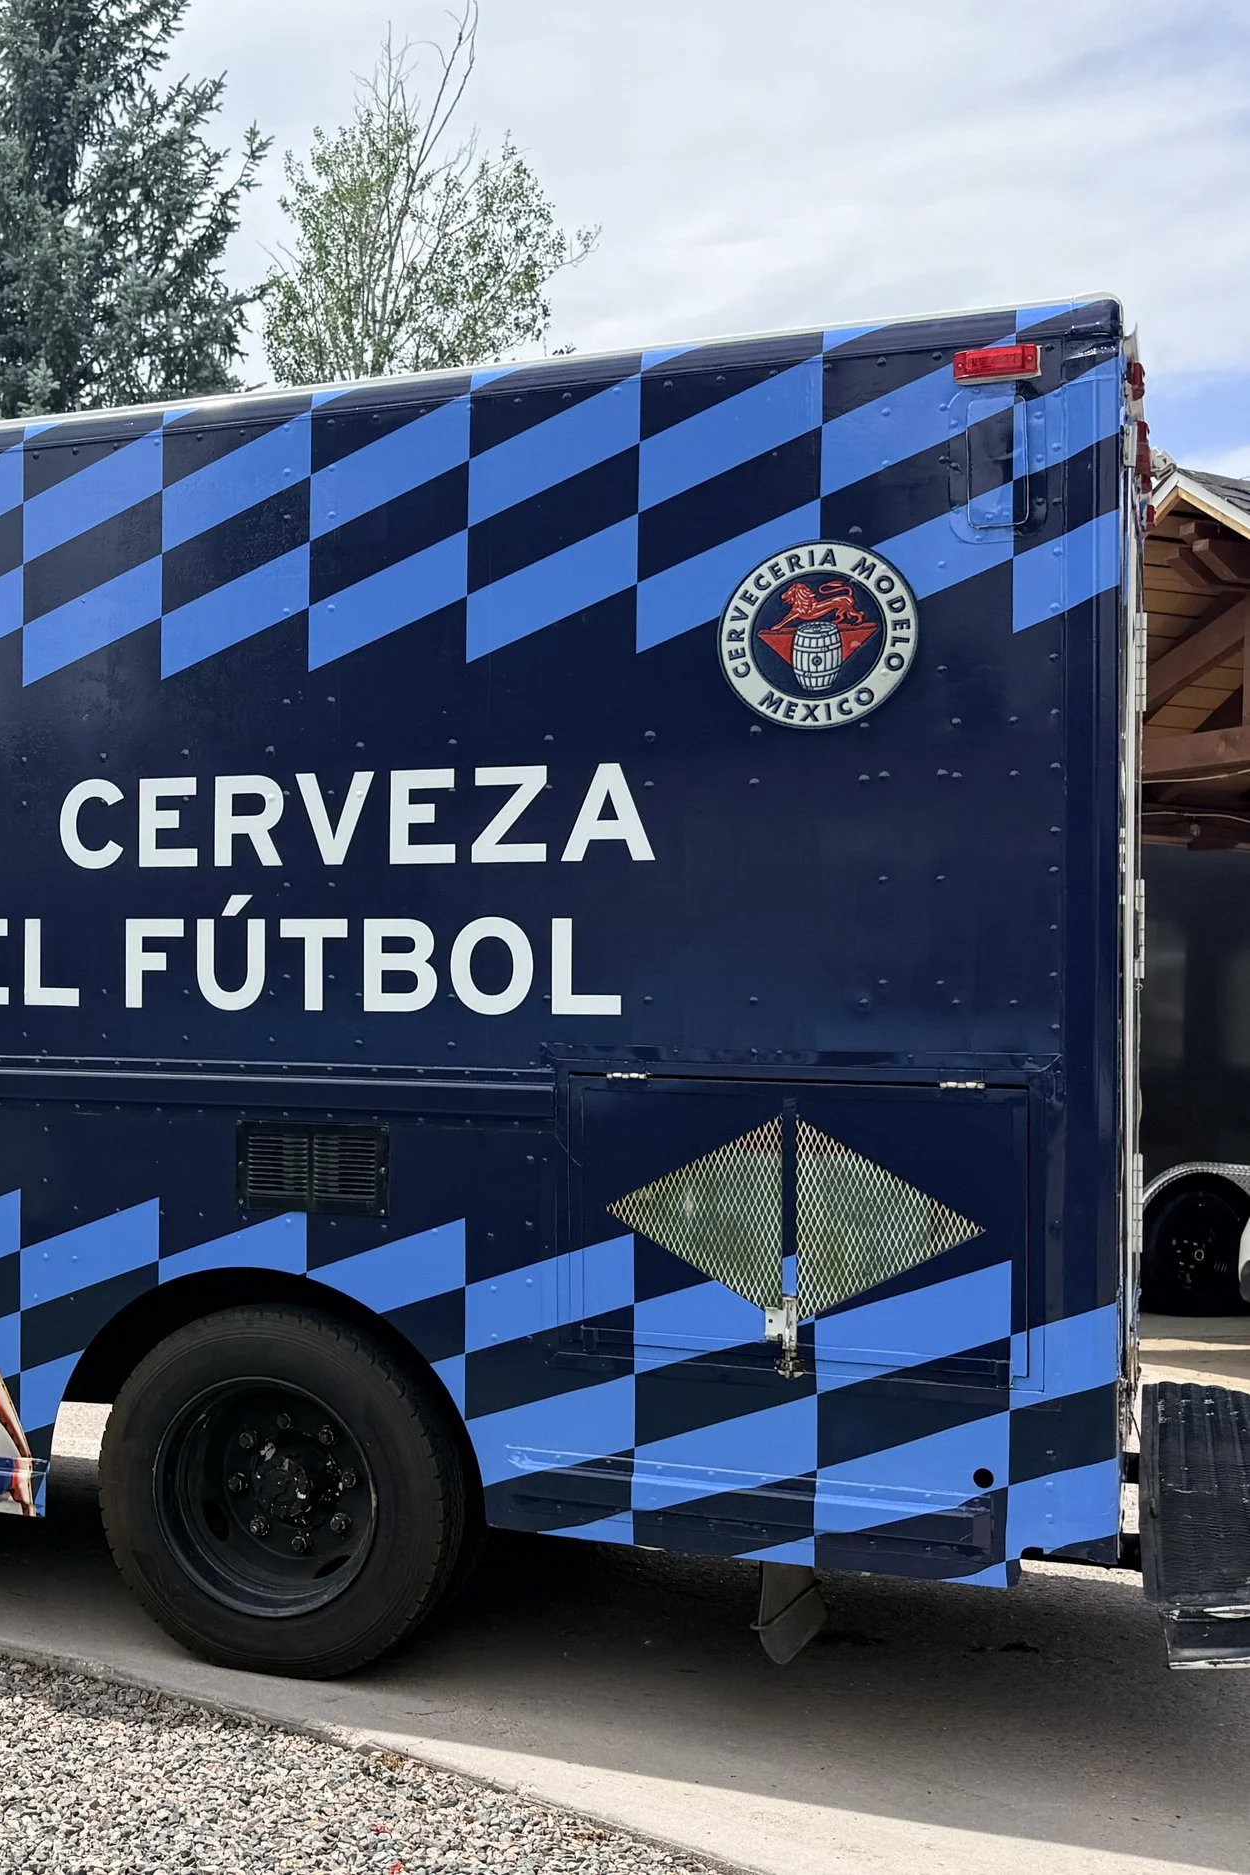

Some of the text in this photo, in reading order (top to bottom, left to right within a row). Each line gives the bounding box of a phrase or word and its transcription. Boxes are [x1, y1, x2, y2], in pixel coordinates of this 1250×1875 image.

[726, 548, 911, 678] CERVECERIA MODELO
[758, 687, 875, 722] MEXICO
[59, 762, 656, 870] CERVEZA
[125, 894, 622, 1016] FÚTBOL
